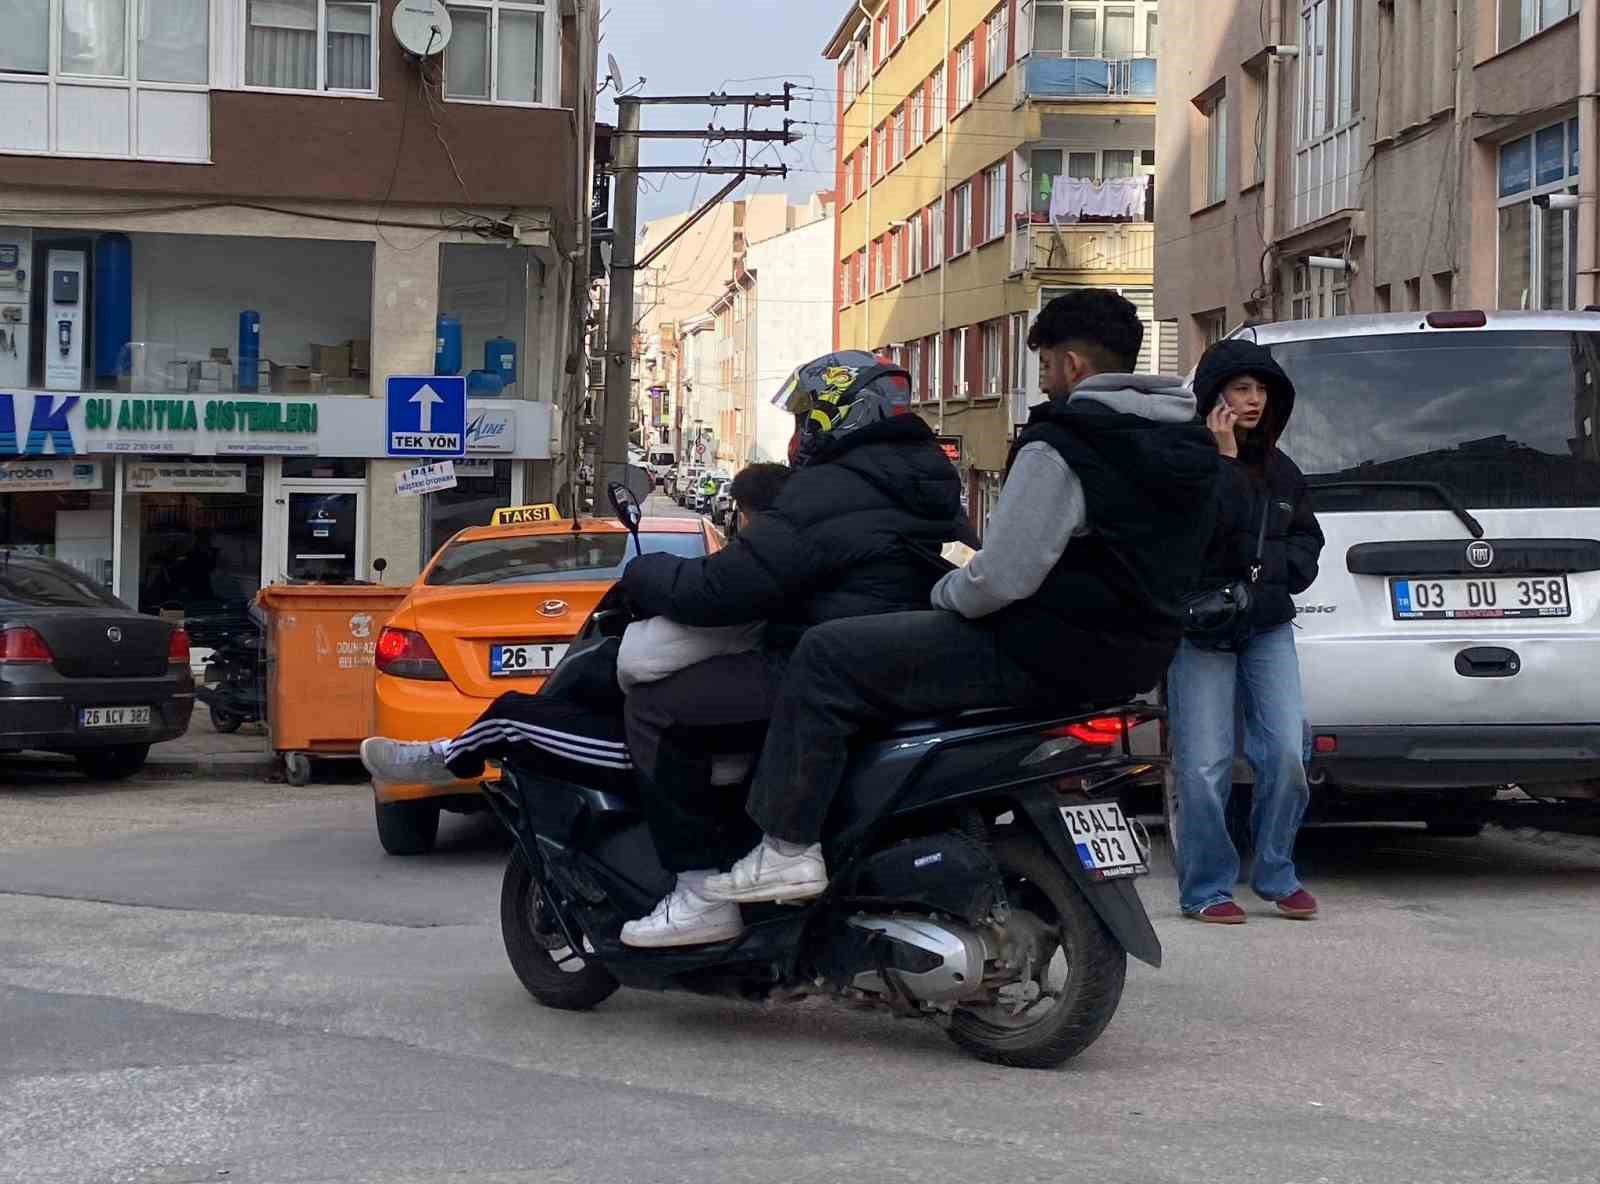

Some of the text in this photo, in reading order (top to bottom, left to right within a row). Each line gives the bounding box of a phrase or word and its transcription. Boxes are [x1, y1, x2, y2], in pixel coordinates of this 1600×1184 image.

[85, 399, 112, 430] SU
[117, 399, 198, 432] ARITMA
[395, 434, 457, 449] TEK YÖN
[502, 507, 547, 523] TAKSİ
[1472, 548, 1488, 561] FIAT
[1415, 579, 1563, 608] 03 DU 358
[502, 646, 554, 668] 26 T
[86, 710, 100, 725] 26
[1066, 807, 1126, 835] 26 ALZ
[1091, 837, 1126, 863] 873
